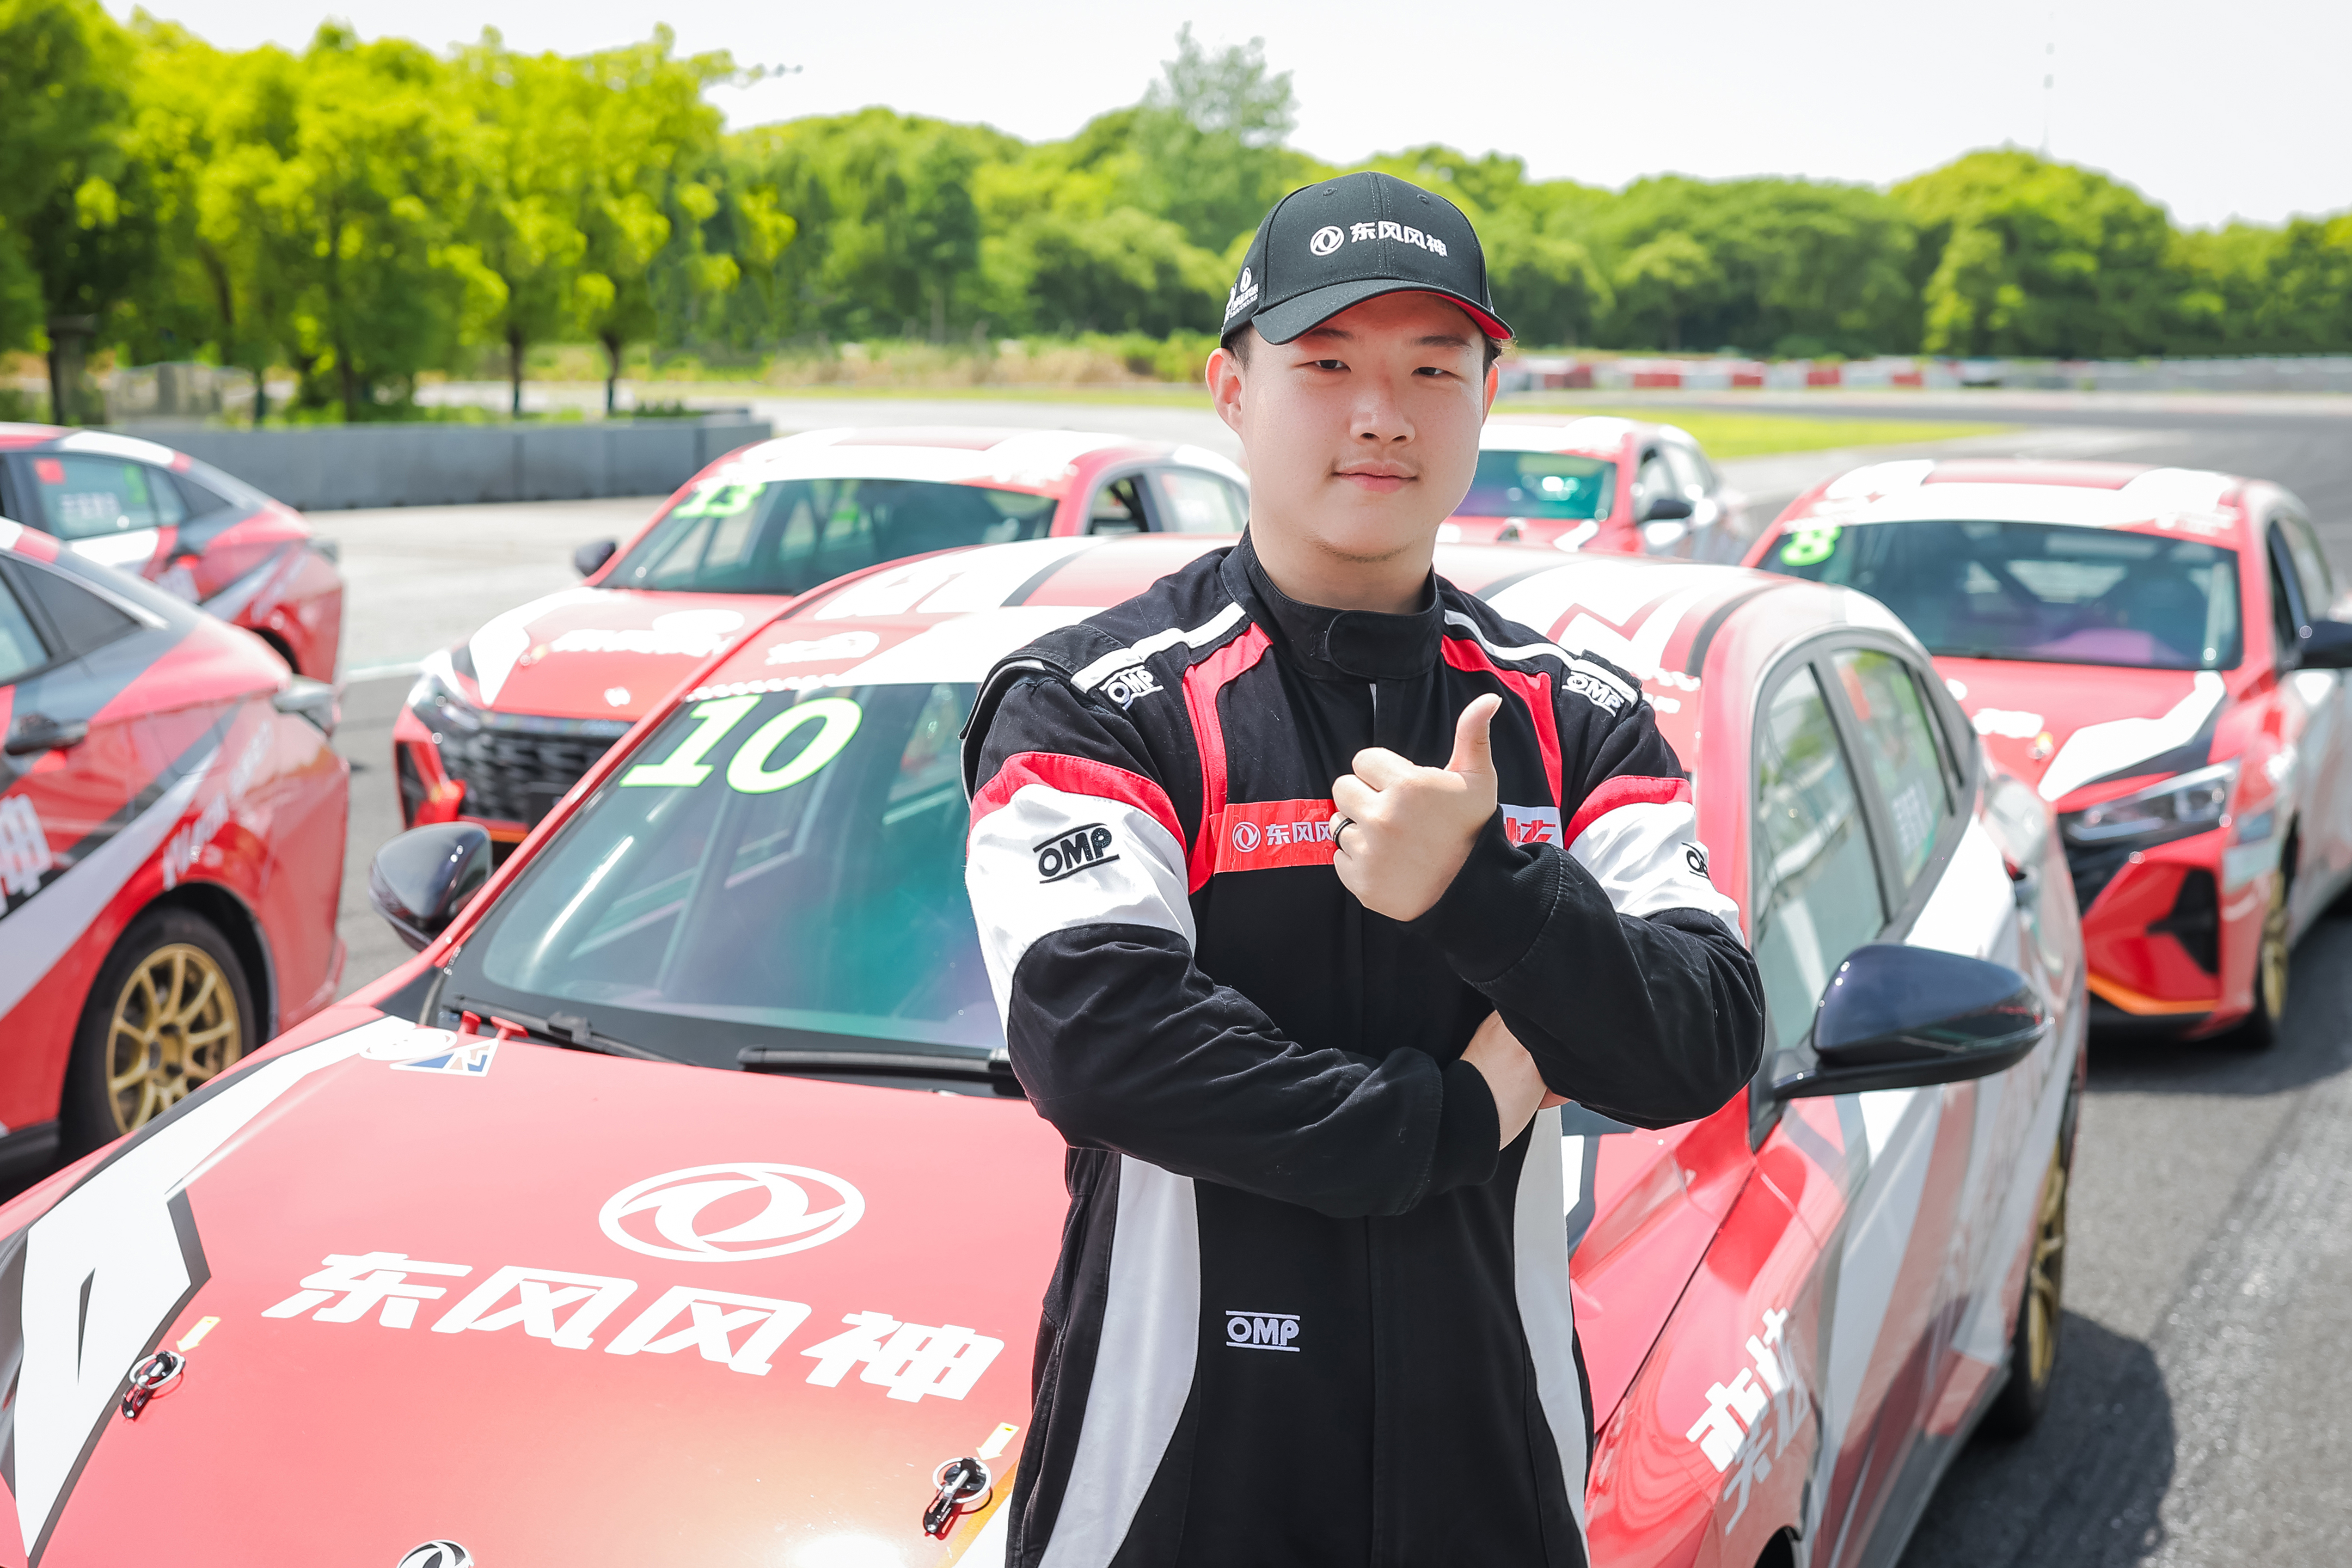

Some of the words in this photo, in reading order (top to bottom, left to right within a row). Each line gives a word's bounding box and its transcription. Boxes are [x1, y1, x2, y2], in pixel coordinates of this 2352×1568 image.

[1349, 220, 1448, 257] 东风风神
[1107, 669, 1154, 704] OMP
[1566, 675, 1621, 709] OMP
[619, 694, 864, 795] 10
[1265, 821, 1334, 846] 东风风
[1038, 827, 1113, 877] OMP
[260, 1250, 1006, 1403] 东风风神
[1227, 1317, 1299, 1347] OMP
